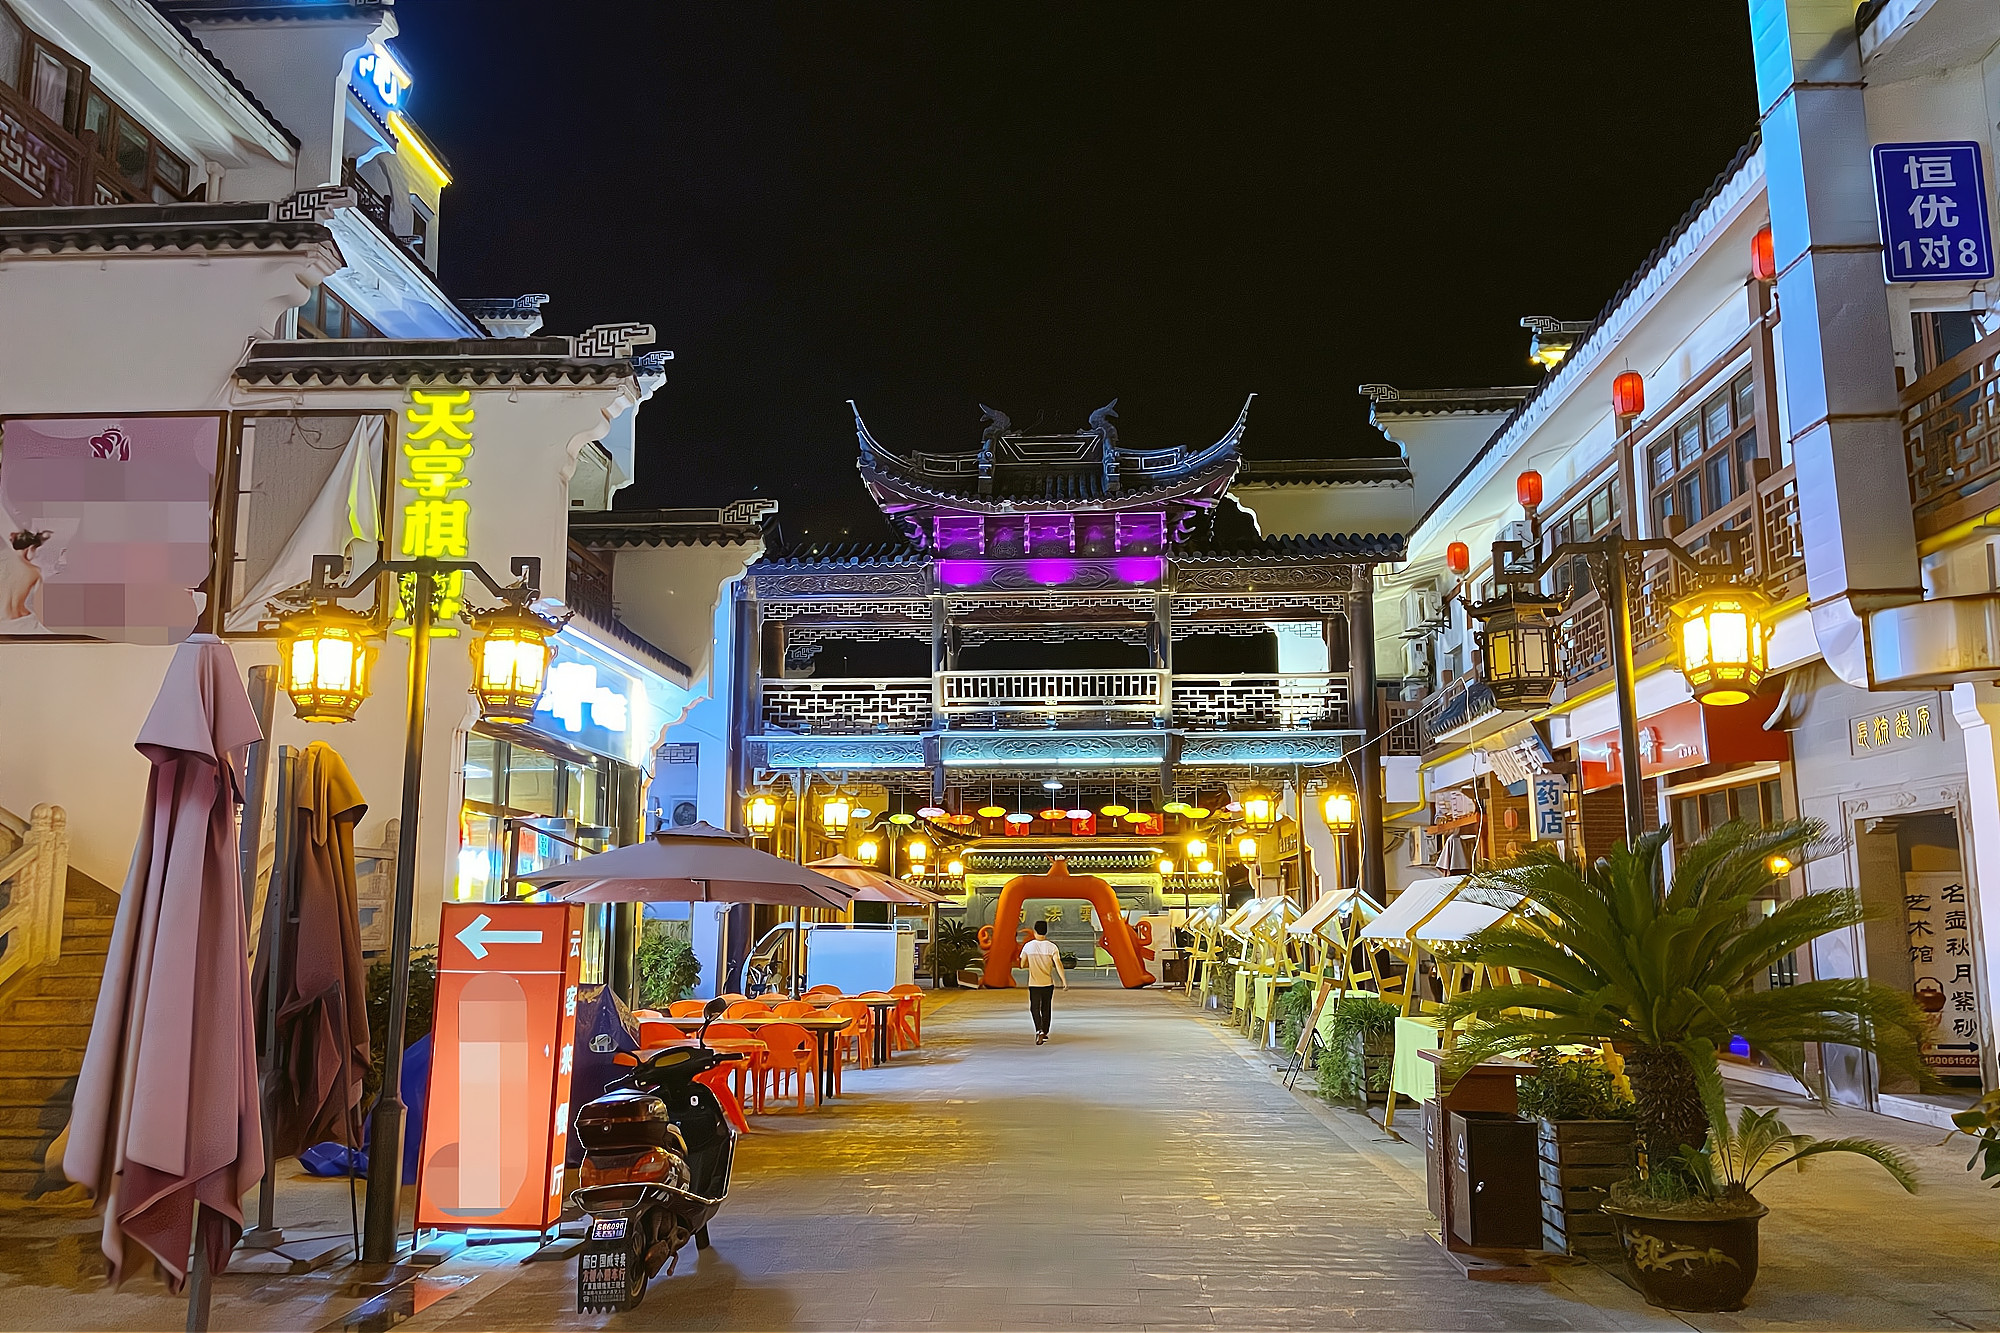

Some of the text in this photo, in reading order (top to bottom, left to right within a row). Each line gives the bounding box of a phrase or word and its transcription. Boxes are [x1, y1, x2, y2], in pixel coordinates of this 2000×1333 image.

[1903, 155, 1957, 190] 恒
[1908, 194, 1960, 229] 优
[1897, 234, 1979, 269] 1对8
[1535, 780, 1563, 834] 药店
[1904, 894, 1934, 963] 艺术馆
